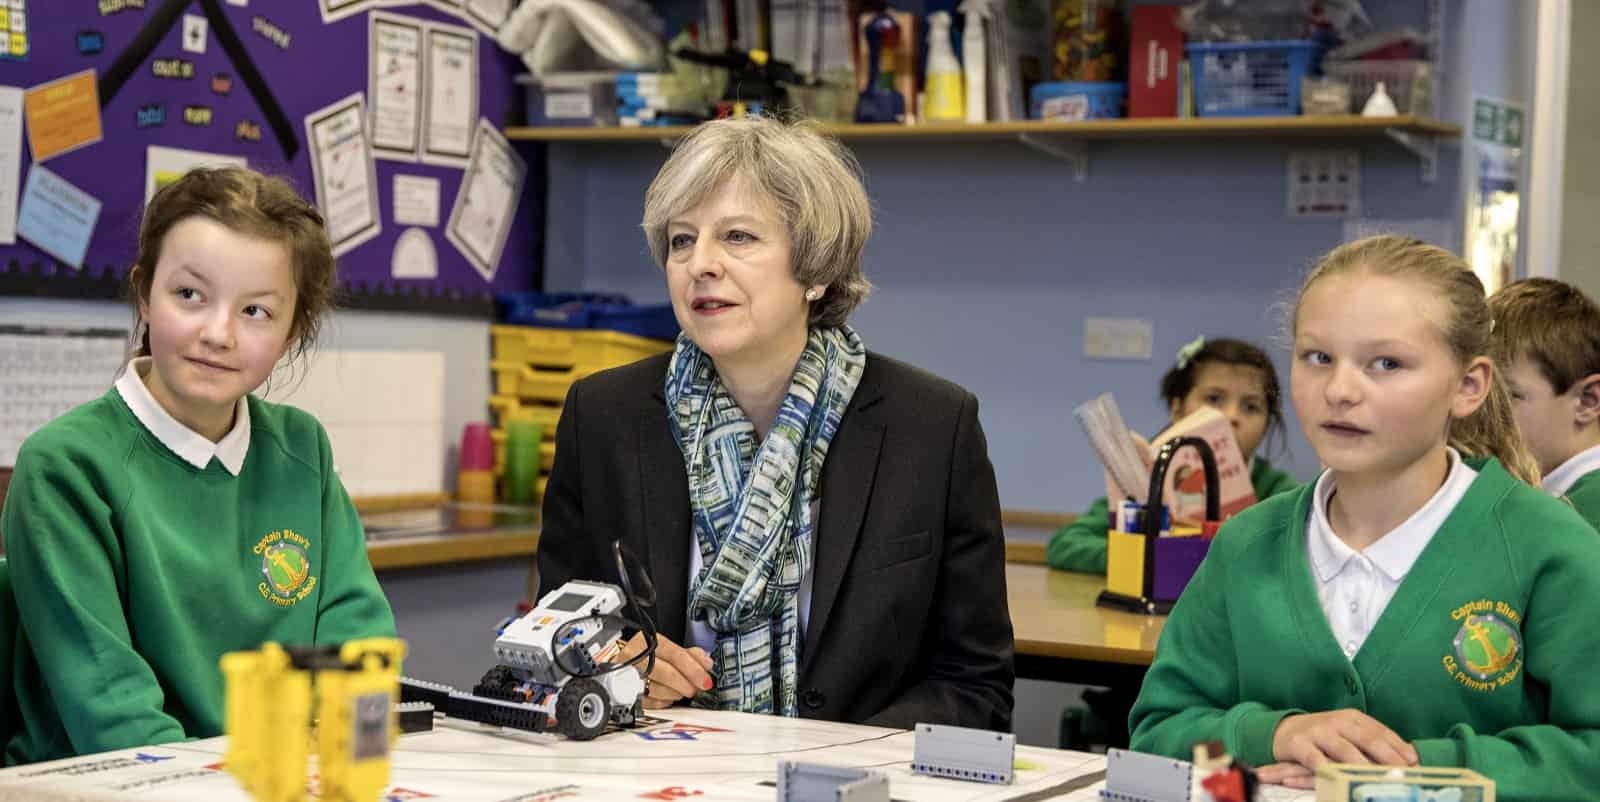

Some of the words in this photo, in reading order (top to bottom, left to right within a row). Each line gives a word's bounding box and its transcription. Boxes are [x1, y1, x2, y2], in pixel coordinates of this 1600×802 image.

[254, 531, 281, 553] Captain
[270, 593, 297, 608] Primary
[298, 577, 316, 600] School
[1451, 600, 1494, 620] Captain
[1496, 601, 1521, 624] Shaw
[1456, 671, 1497, 691] Primary
